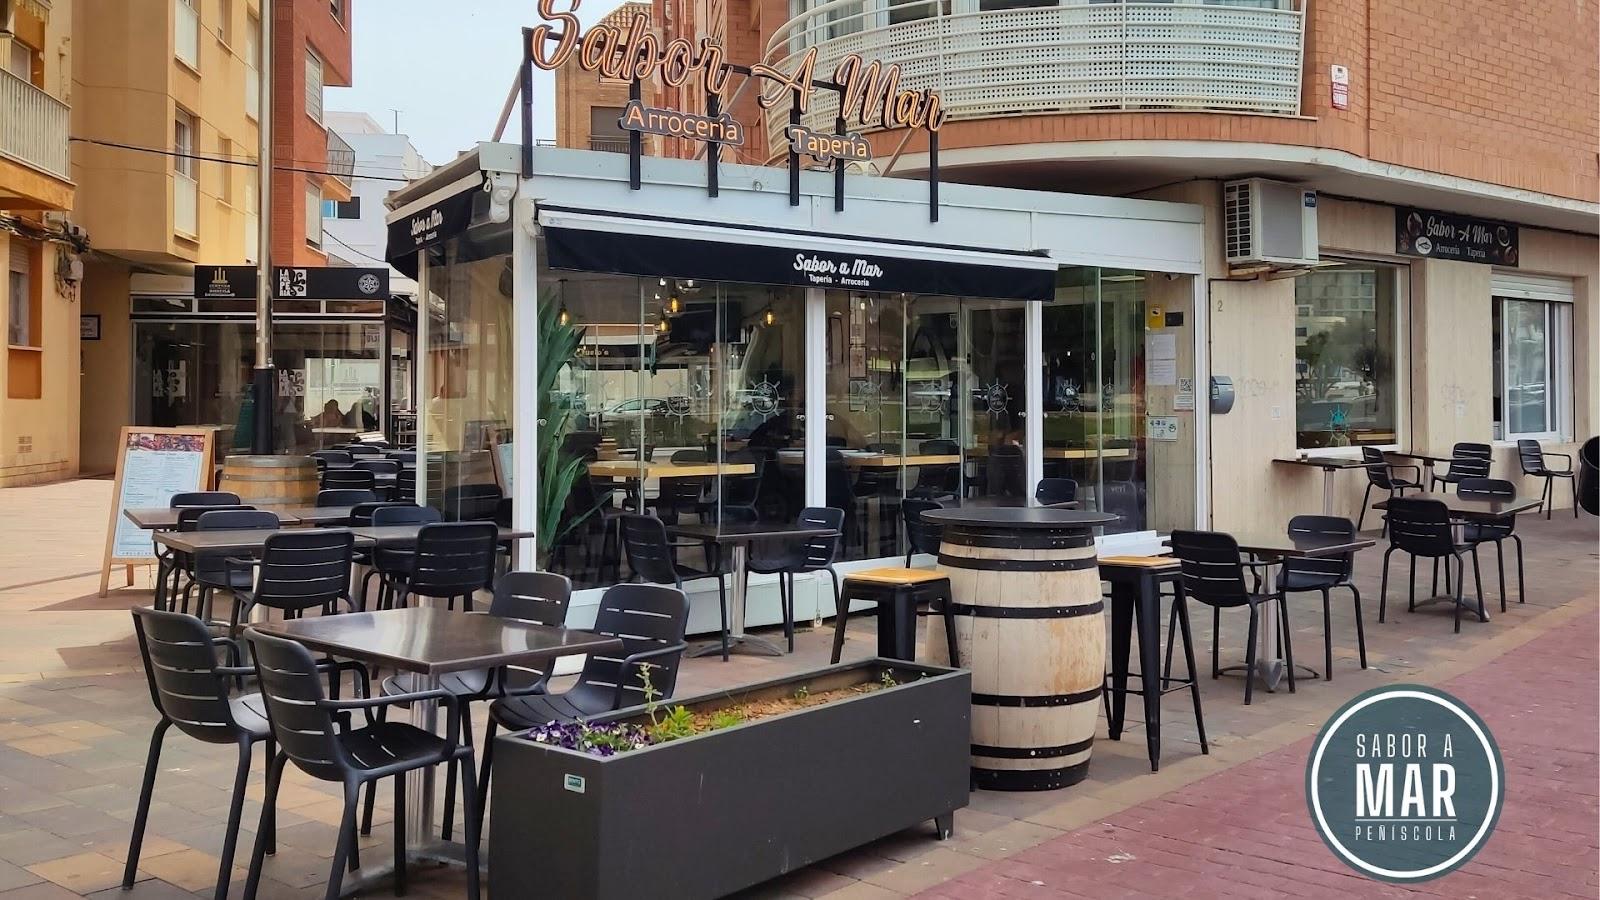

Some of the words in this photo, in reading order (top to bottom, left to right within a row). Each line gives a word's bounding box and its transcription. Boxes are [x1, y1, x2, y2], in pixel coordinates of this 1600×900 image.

[532, 0, 735, 95] Sabor
[749, 45, 818, 115] A
[833, 54, 946, 131] Mar
[627, 105, 738, 141] Arrocería
[792, 128, 867, 157] Tapería
[1426, 216, 1455, 239] Sabor
[1458, 224, 1471, 242] A
[1472, 225, 1493, 244] Mar
[793, 253, 837, 274] Sabor
[839, 262, 850, 274] a
[851, 259, 883, 277] Mar
[809, 273, 832, 284] Tapería
[841, 277, 869, 287] Arrocería
[1217, 299, 1223, 312] 2
